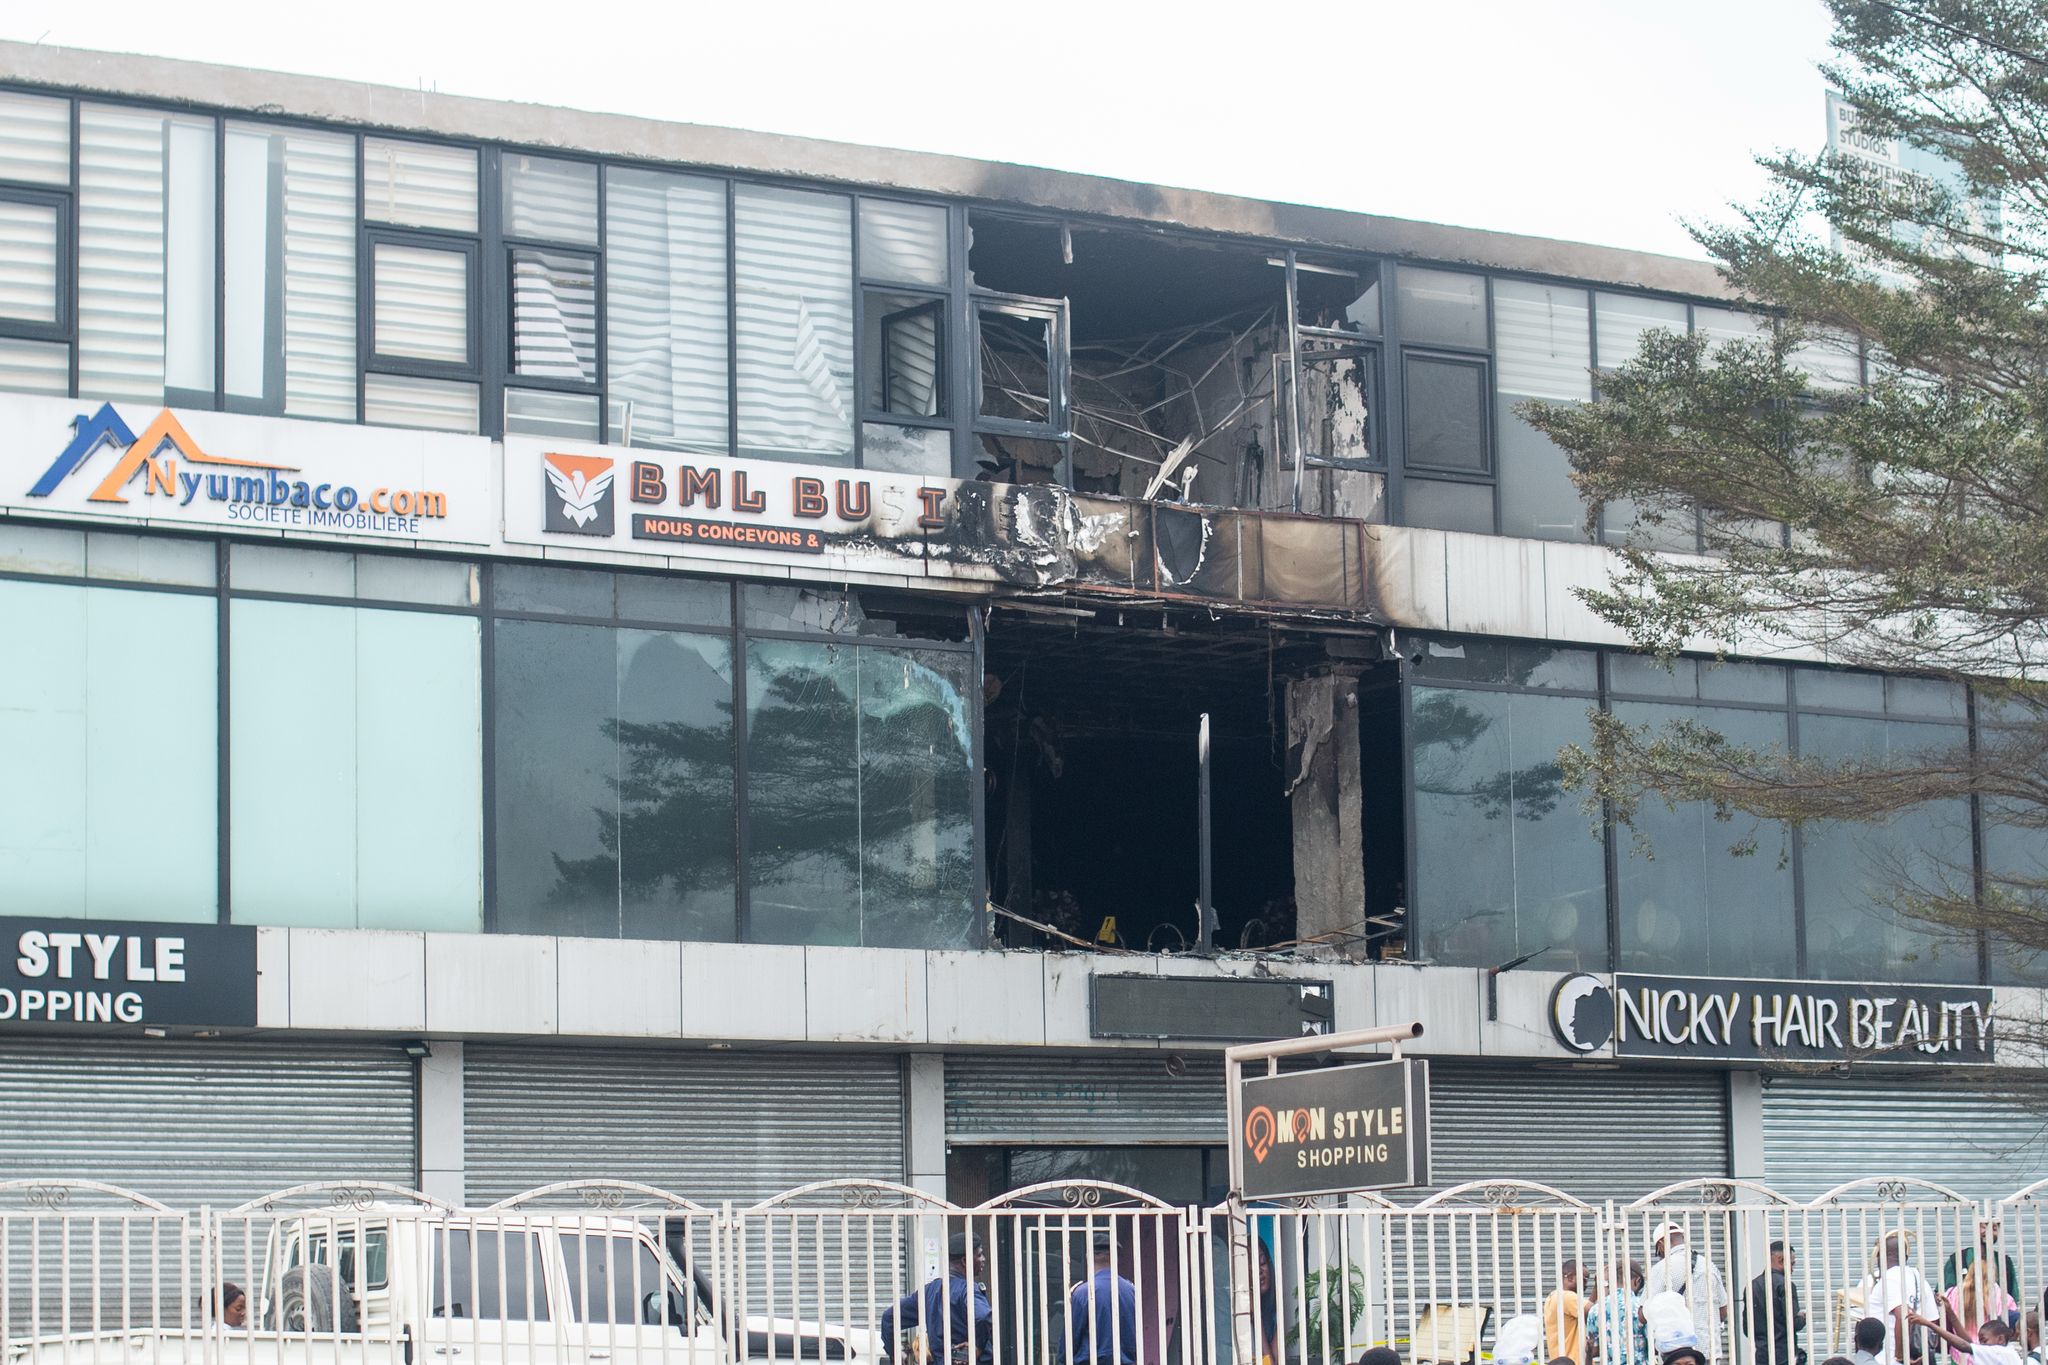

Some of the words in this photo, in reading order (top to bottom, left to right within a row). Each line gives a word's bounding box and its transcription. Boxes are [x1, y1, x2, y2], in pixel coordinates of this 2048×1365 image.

[146, 459, 447, 518] Nyumbaco.com
[630, 460, 768, 514] BML
[228, 504, 302, 524] SOCIETE
[308, 511, 419, 533] IMMOBILIERE
[644, 519, 693, 538] NOUS
[697, 522, 802, 547] CONCEVONS
[806, 531, 819, 548] &
[17, 930, 186, 983] STYLE
[1617, 987, 1741, 1047] NICKY
[1751, 993, 1844, 1050] HAIR
[1848, 997, 1994, 1055] BEAUTY
[1333, 1106, 1403, 1140] STYLE
[1297, 1144, 1388, 1168] SHOPPING
